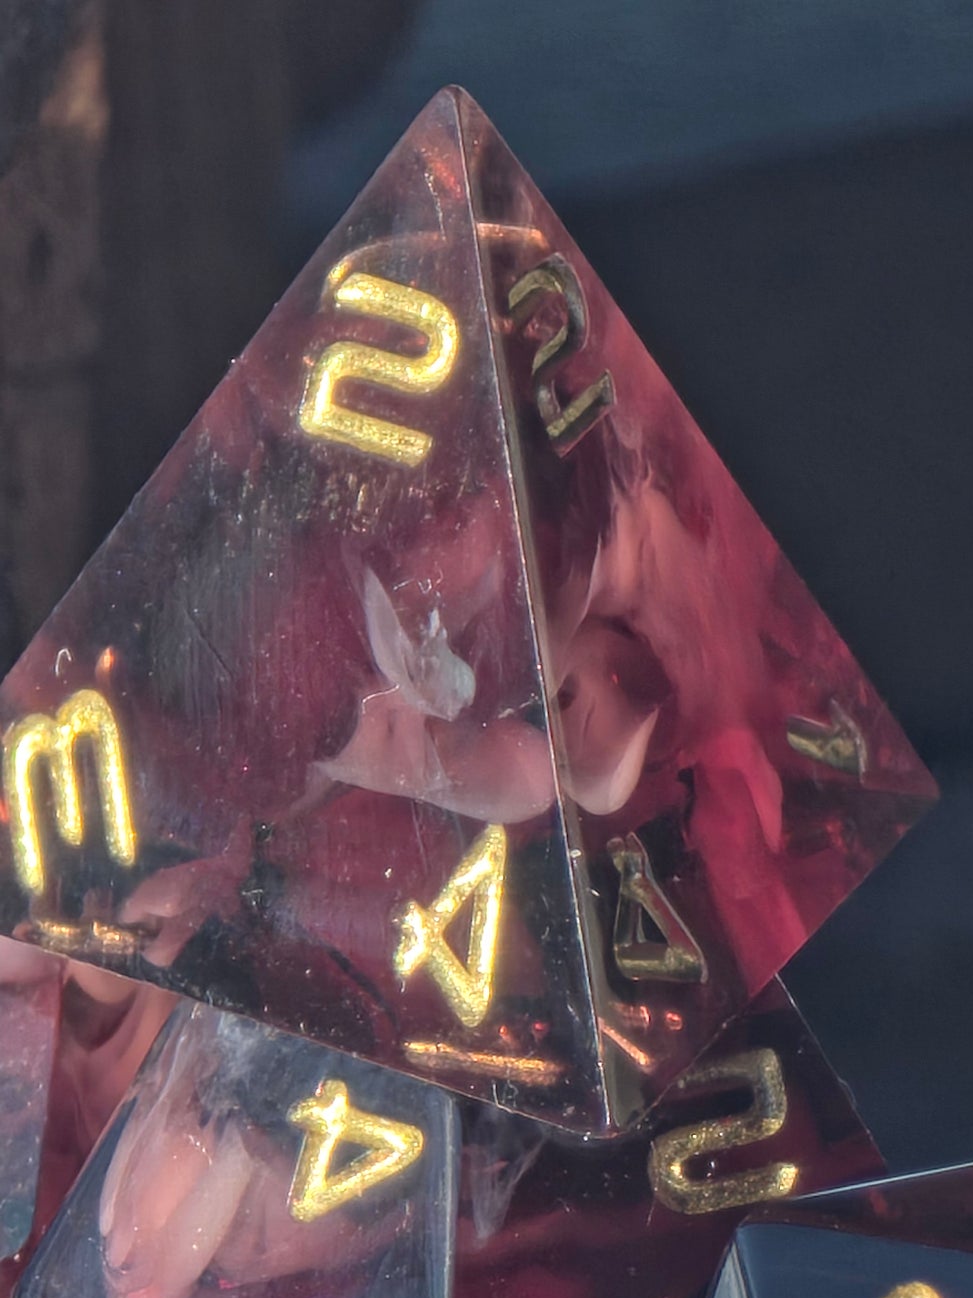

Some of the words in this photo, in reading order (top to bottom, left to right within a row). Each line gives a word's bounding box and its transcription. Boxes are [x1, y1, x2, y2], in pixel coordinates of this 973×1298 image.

[299, 270, 460, 469] 2
[507, 252, 617, 459] 2
[2, 688, 137, 897] 3
[395, 823, 507, 1028] 4
[287, 1078, 426, 1224] 4
